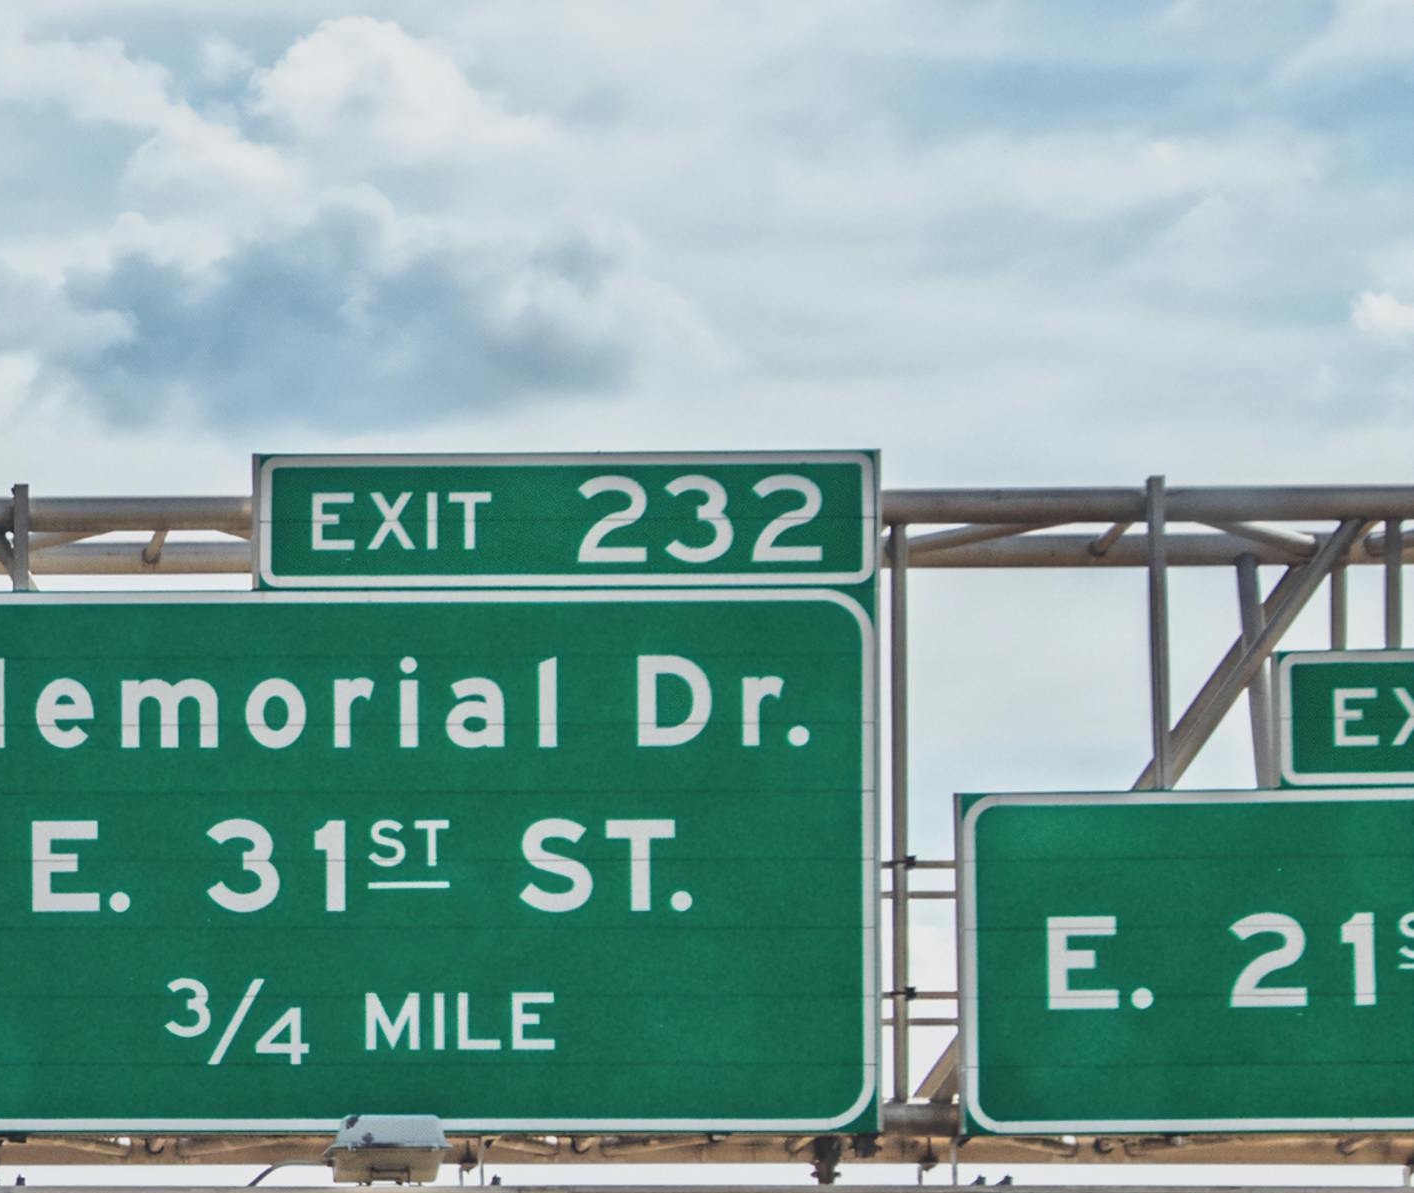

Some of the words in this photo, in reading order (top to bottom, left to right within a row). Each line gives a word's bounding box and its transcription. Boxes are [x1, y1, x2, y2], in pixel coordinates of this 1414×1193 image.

[312, 492, 492, 550] EXIT
[578, 475, 822, 563] 232
[637, 655, 810, 747] Dr.
[31, 820, 130, 913] E.
[207, 818, 450, 913] 31ST
[519, 818, 693, 913] ST.
[1047, 916, 1153, 1009] E.
[165, 978, 309, 1065] 3/4
[365, 992, 555, 1050] MILE
